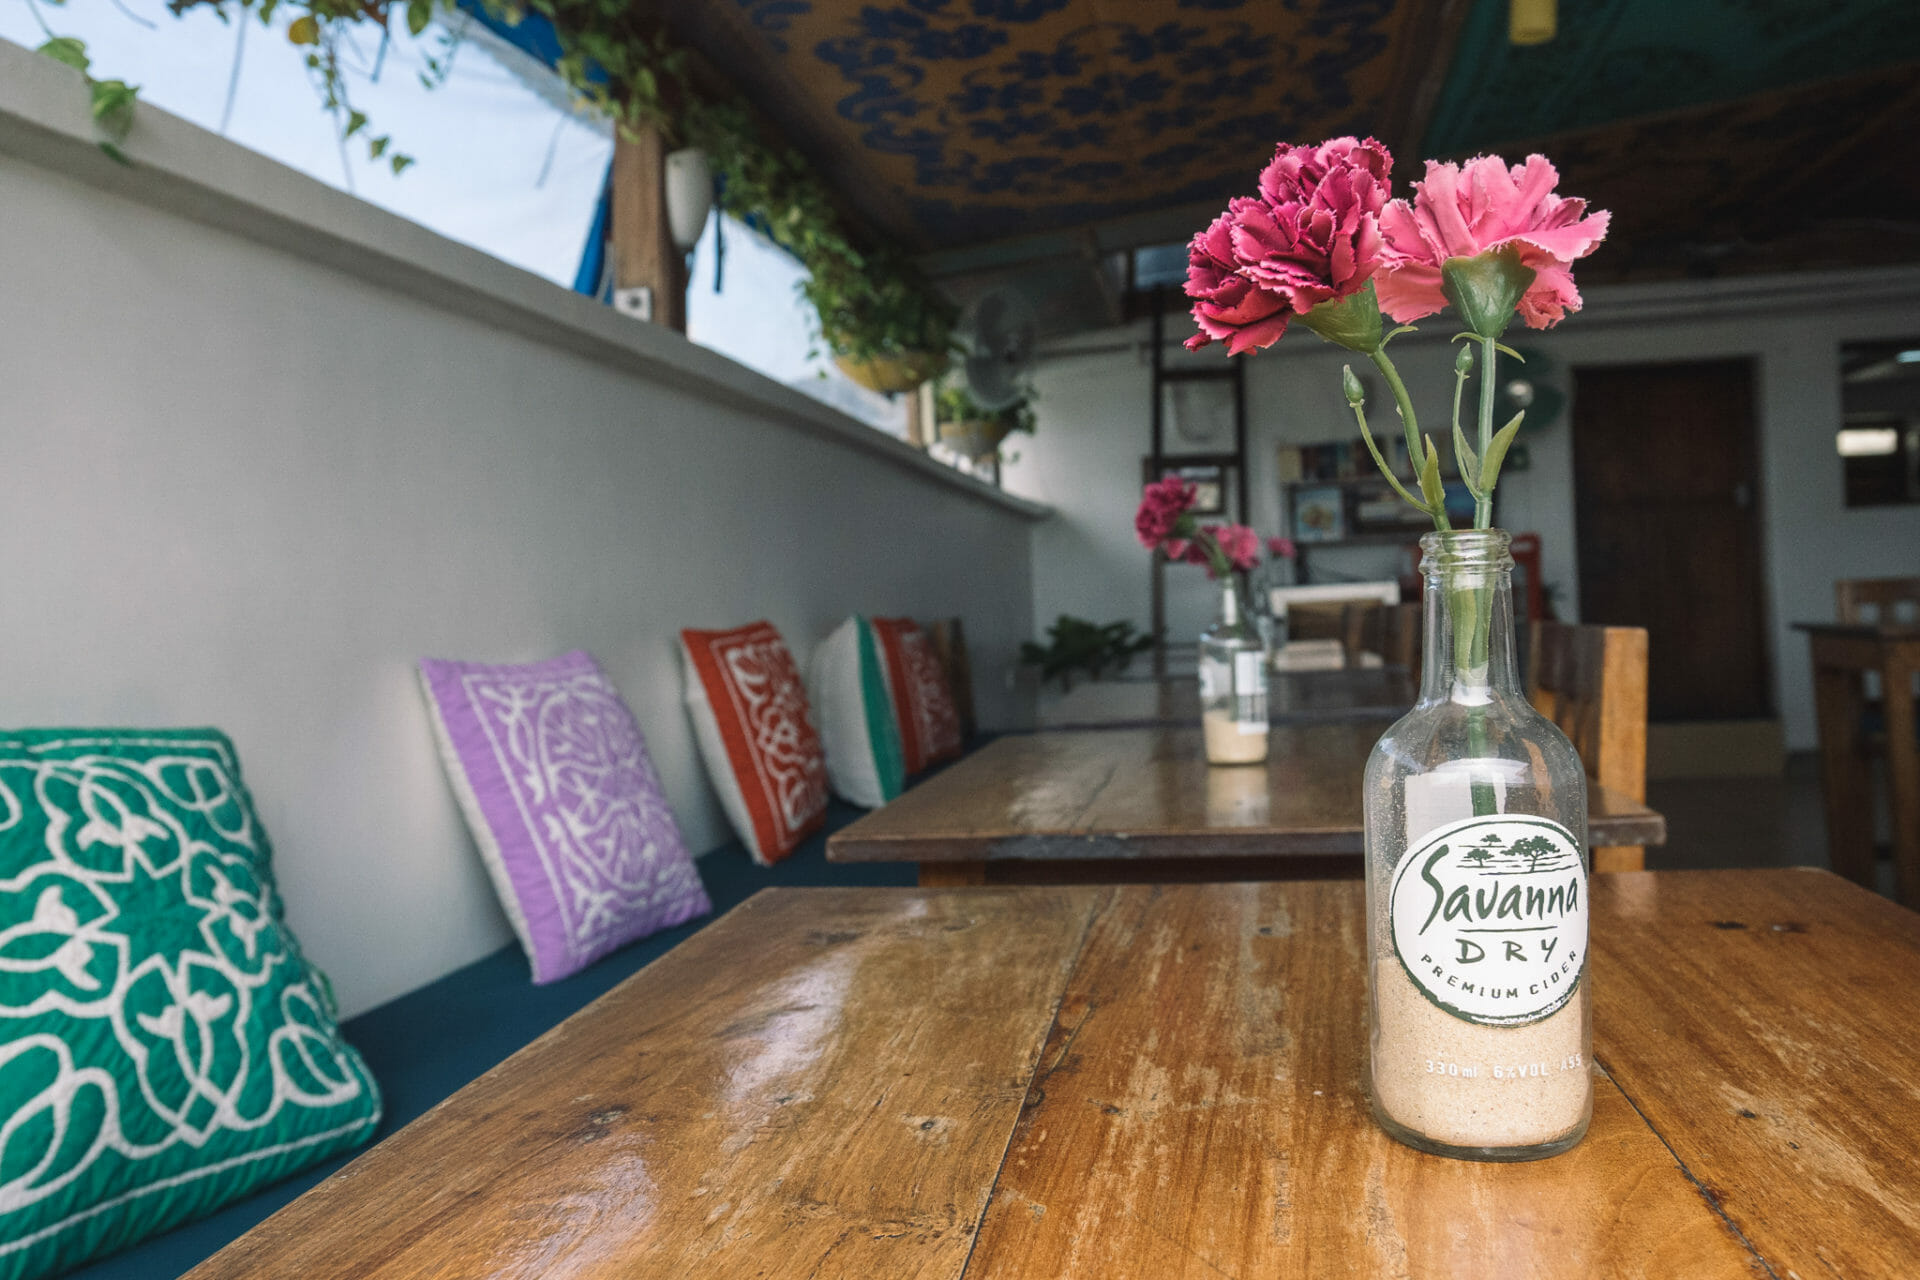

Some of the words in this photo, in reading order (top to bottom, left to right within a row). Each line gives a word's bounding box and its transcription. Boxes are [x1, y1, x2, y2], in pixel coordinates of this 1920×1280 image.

[1418, 844, 1578, 935] Savanna
[1455, 937, 1558, 964] DRY
[1421, 954, 1519, 999] PREMIUM
[1529, 951, 1577, 995] CIDER
